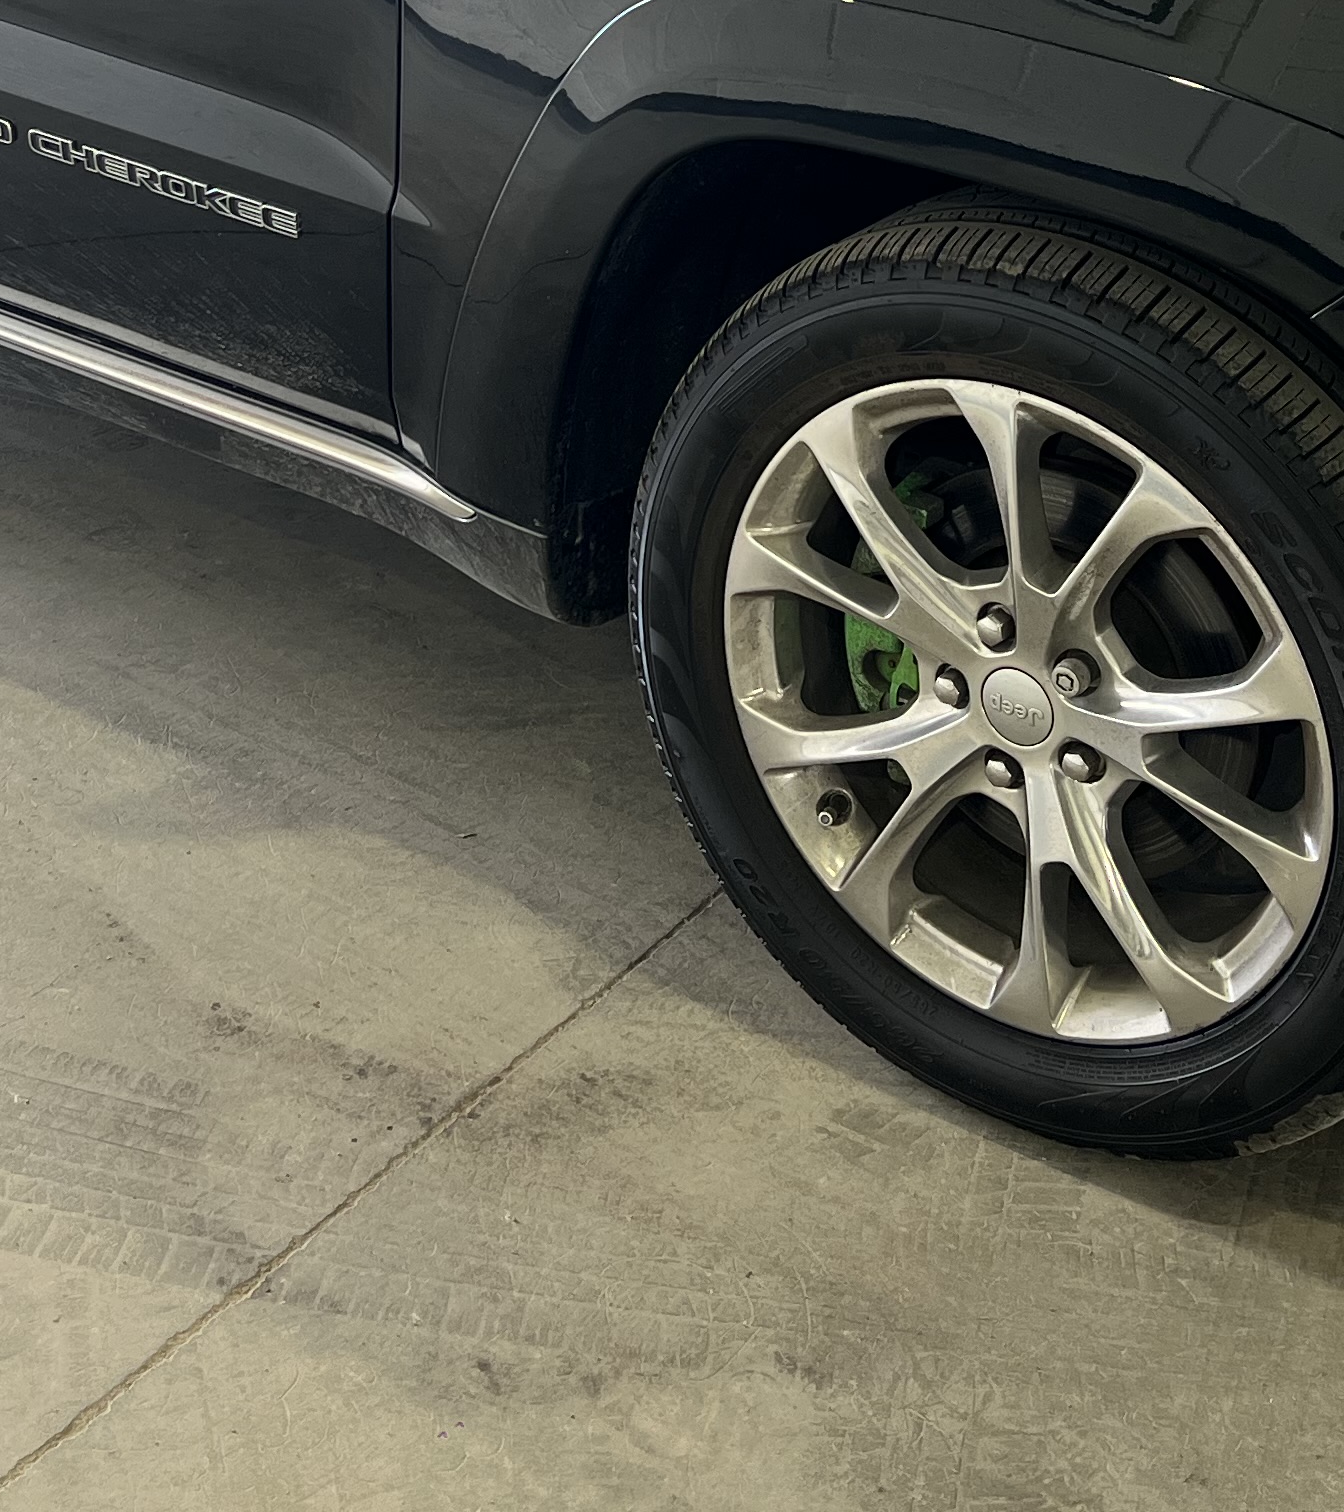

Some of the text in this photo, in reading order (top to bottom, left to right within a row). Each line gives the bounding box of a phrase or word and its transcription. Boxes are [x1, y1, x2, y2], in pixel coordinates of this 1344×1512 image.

[27, 127, 303, 239] CHEROKEE
[989, 692, 1045, 728] Jeep
[729, 853, 801, 944] R20
